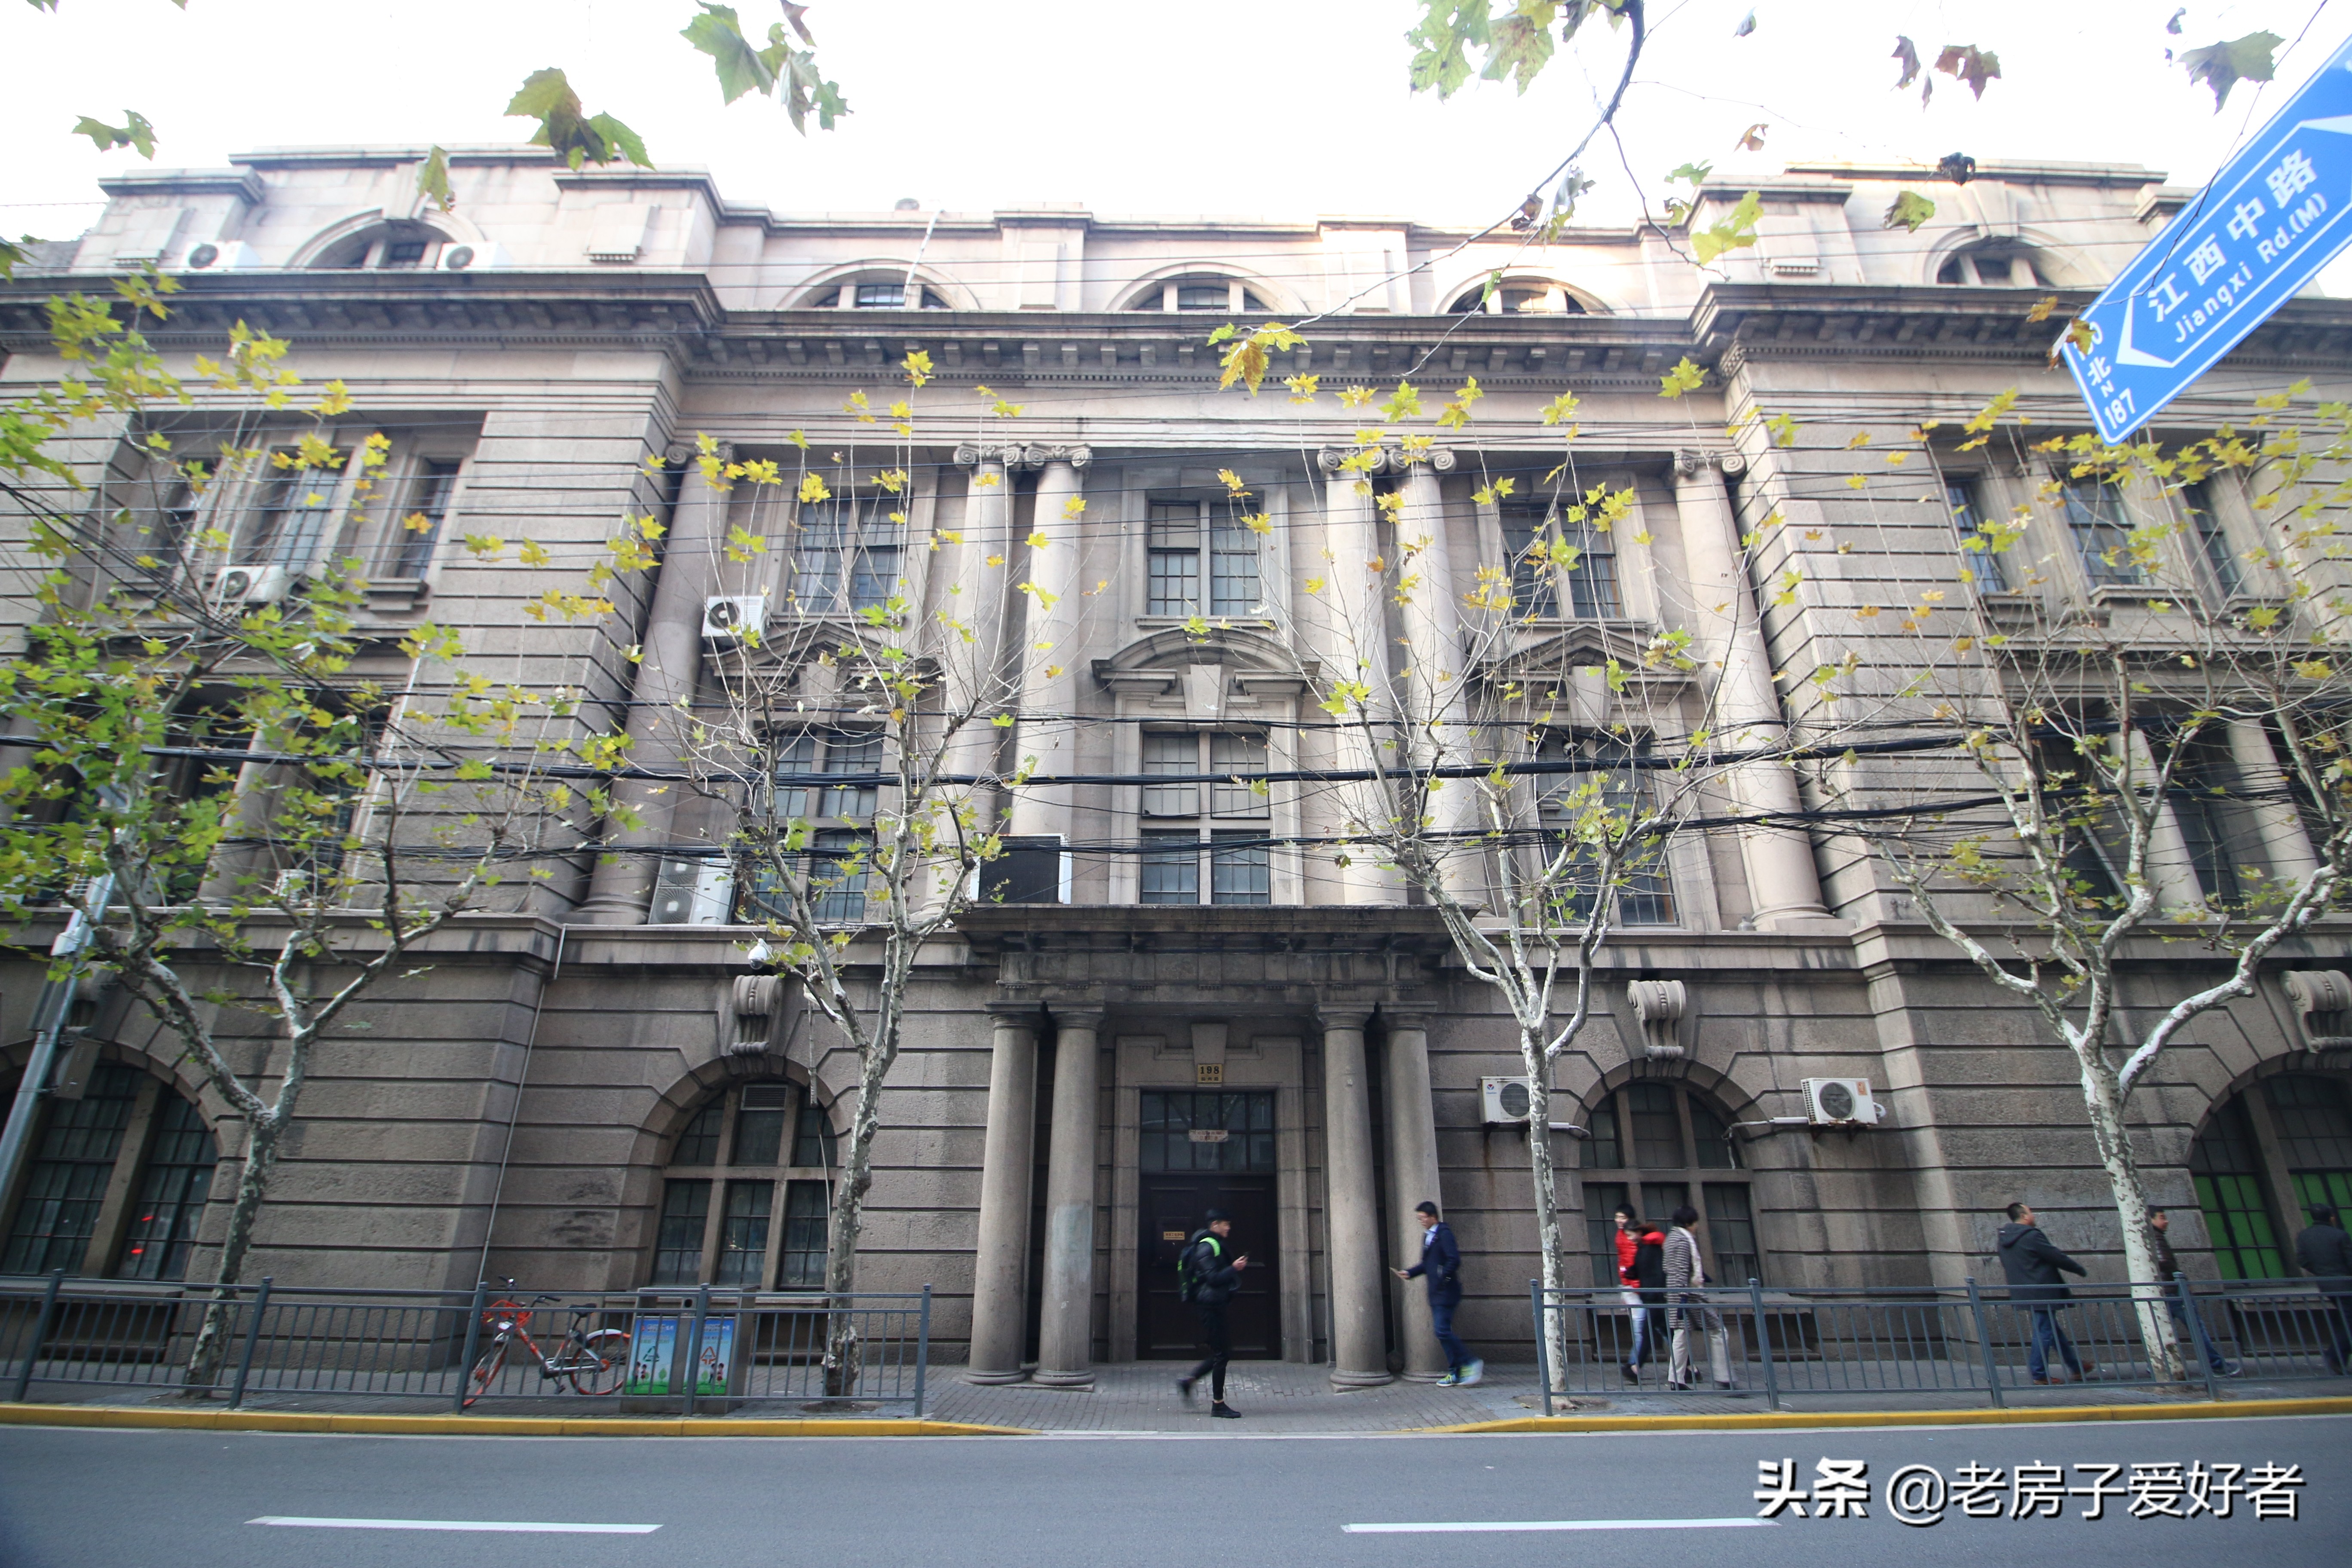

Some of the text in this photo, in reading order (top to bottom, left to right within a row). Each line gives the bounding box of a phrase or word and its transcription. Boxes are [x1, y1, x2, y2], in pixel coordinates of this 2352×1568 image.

[2148, 149, 2317, 322] 江西中路
[2176, 261, 2253, 343] Jiangxi
[2256, 193, 2328, 264] Rd.(M)
[2088, 357, 2111, 386] 北
[2101, 380, 2114, 398] N
[2104, 388, 2135, 429] 187
[1200, 1066, 1219, 1074] 198
